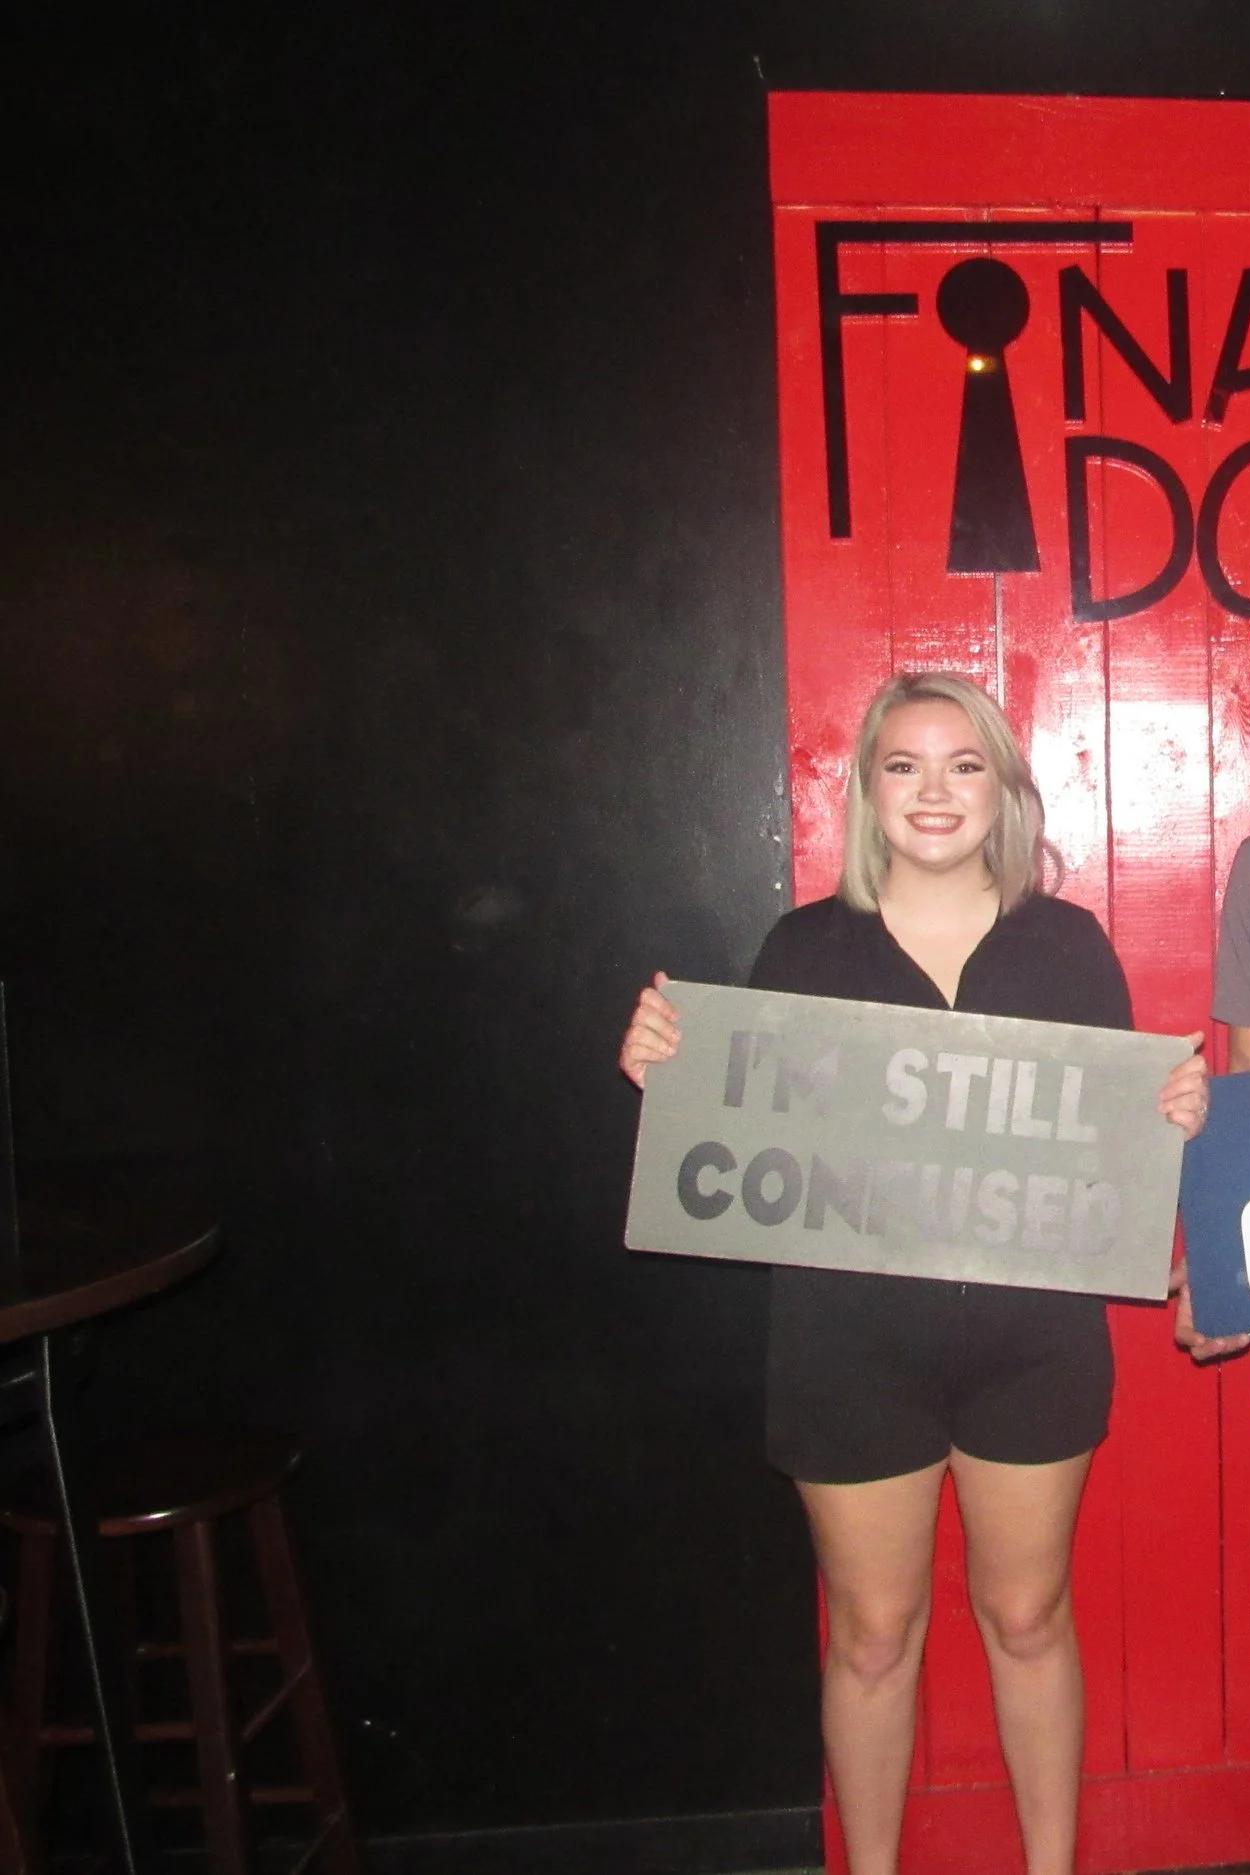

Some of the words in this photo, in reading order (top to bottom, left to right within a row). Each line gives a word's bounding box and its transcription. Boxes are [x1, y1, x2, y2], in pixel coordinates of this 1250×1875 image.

[723, 1030, 840, 1114] I'M
[881, 1047, 1099, 1143] STILL
[677, 1140, 1122, 1257] CONFUSED
